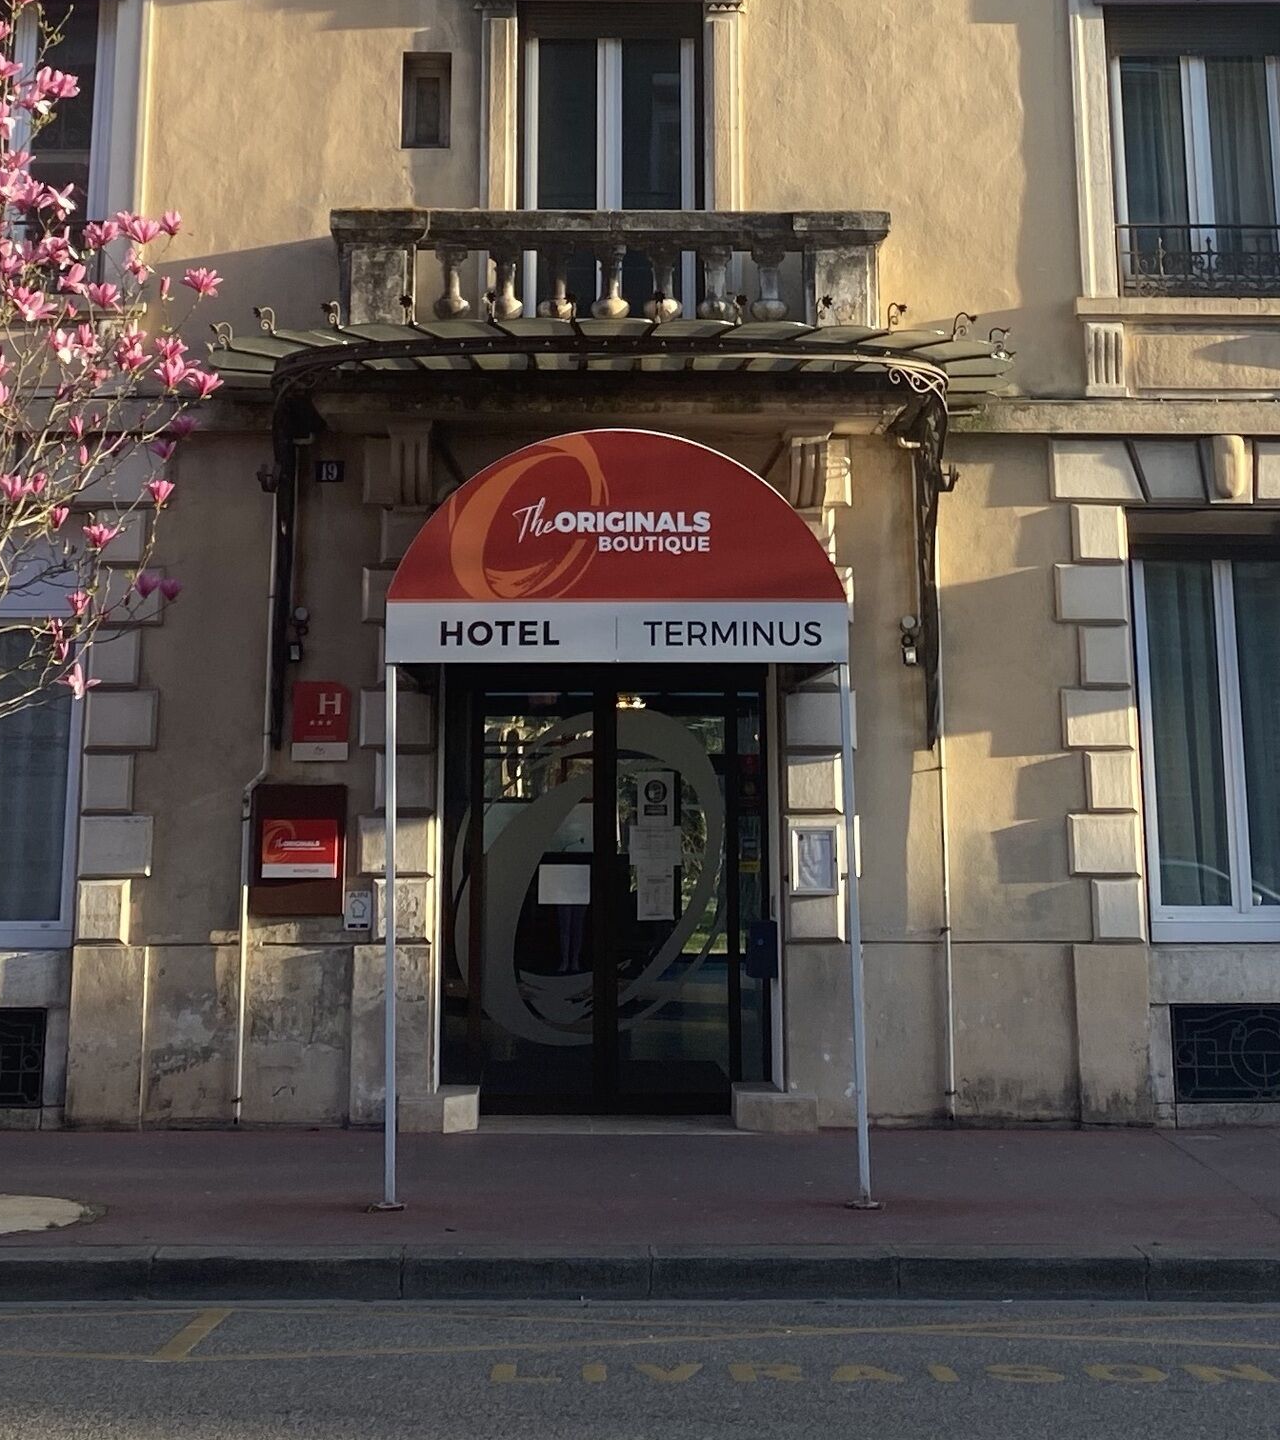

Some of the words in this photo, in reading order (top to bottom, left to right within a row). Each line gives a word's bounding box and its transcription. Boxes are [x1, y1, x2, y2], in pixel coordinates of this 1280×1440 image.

[321, 463, 338, 481] 19
[512, 497, 556, 544] The
[554, 511, 711, 533] ORIGINALS
[598, 536, 711, 555] BOUTIQUE
[440, 620, 560, 647] HOTEL
[643, 620, 822, 647] TERMINUS
[318, 692, 342, 715] H
